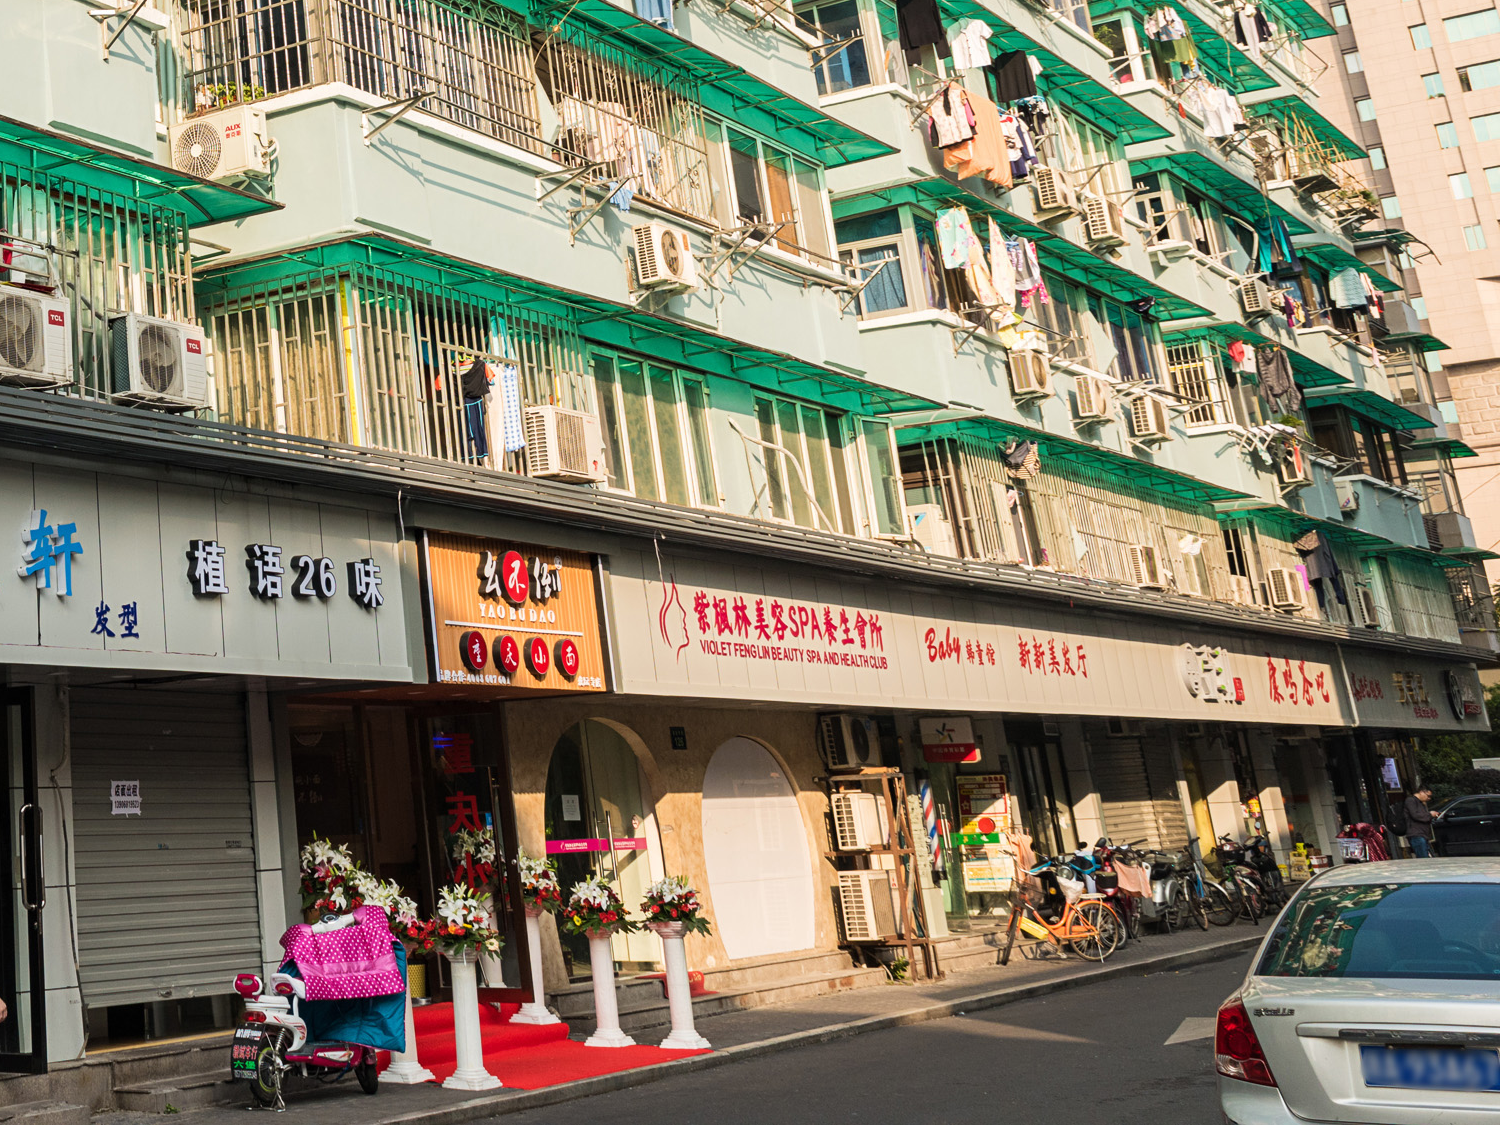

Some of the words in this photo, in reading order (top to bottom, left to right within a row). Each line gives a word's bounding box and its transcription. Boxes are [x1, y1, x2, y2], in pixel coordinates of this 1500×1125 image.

[225, 123, 241, 132] AUX
[50, 314, 62, 322] TCL
[188, 342, 199, 350] TCL
[190, 540, 384, 609] 植语26味
[91, 601, 140, 639] 发型
[479, 603, 505, 619] YAO
[510, 607, 526, 621] BU
[529, 609, 556, 623] DAO
[700, 639, 731, 657] VIOLET
[771, 646, 804, 663] BEAUTY
[807, 651, 822, 665] SPA
[823, 652, 839, 666] AND
[841, 653, 869, 667] HEALTH
[869, 656, 888, 670] CLUB
[925, 627, 961, 664] Baby
[1018, 634, 1088, 678] 新新美发厅
[115, 784, 137, 796] 店面出租
[233, 1060, 256, 1070] 六堡
